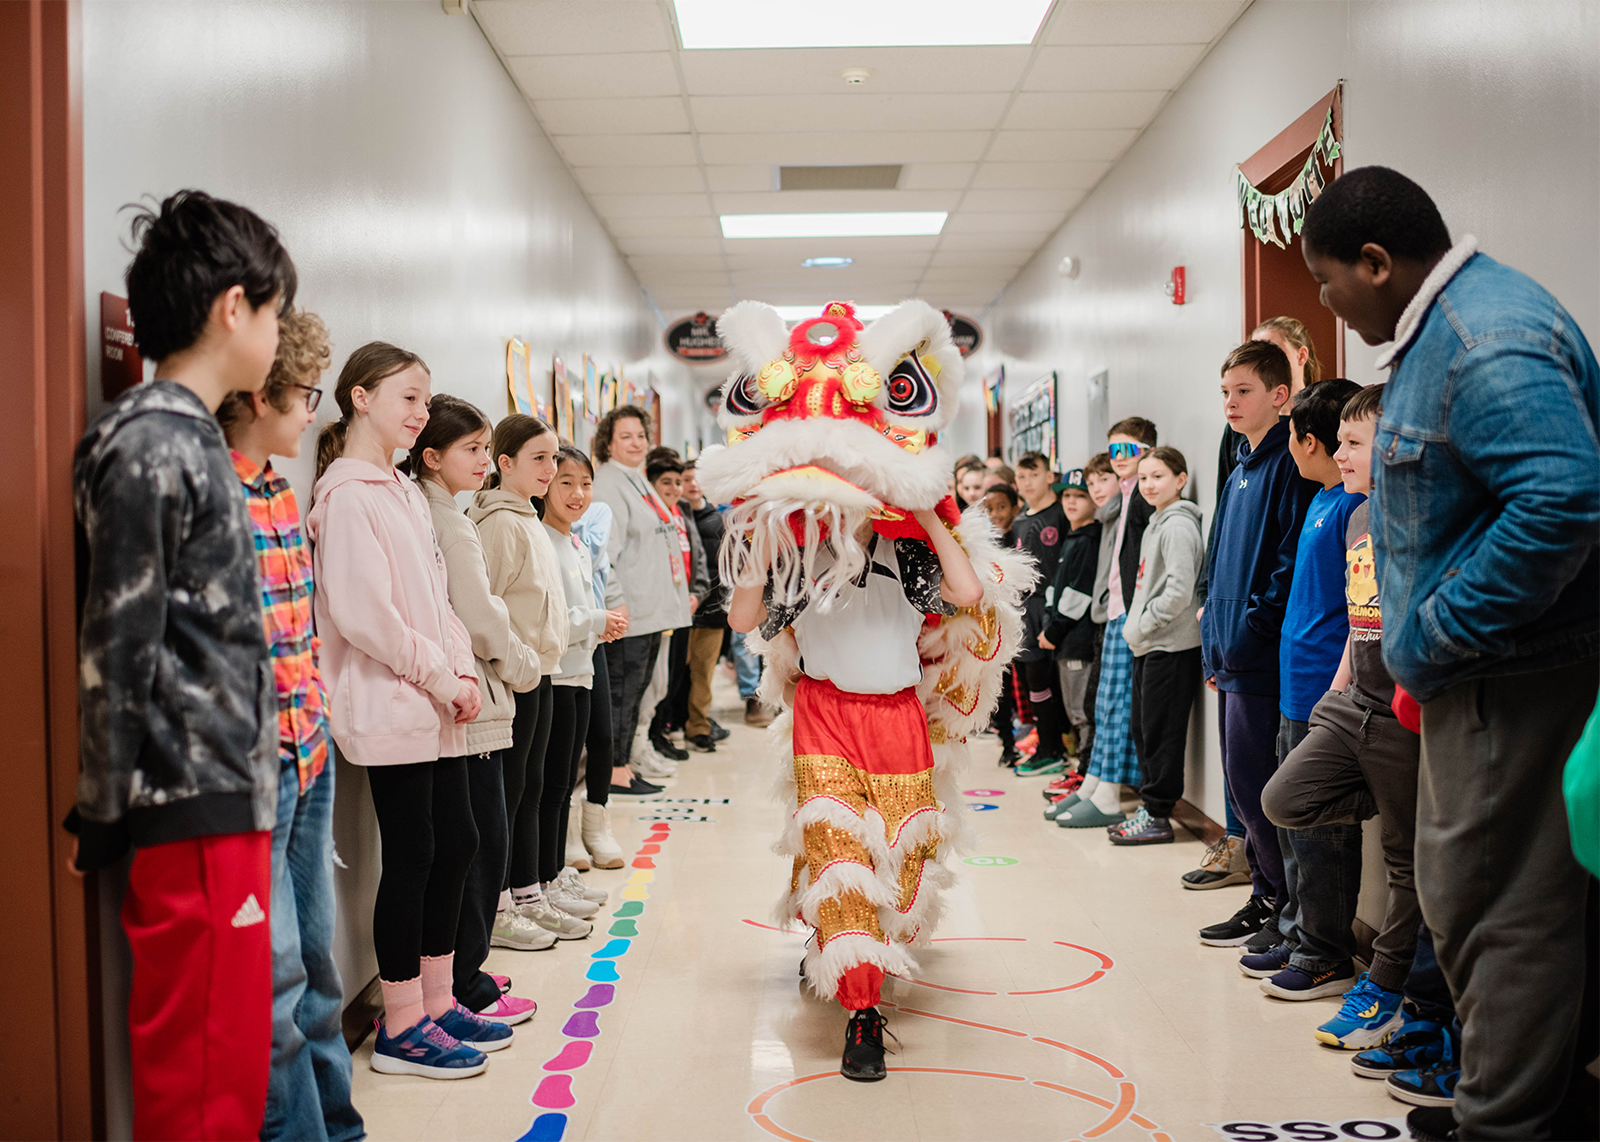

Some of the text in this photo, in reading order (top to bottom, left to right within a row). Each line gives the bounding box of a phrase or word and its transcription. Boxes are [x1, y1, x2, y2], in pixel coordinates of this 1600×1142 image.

[106, 345, 123, 360] ROOM
[972, 857, 1008, 865] 10
[1222, 1120, 1401, 1142] OSS
